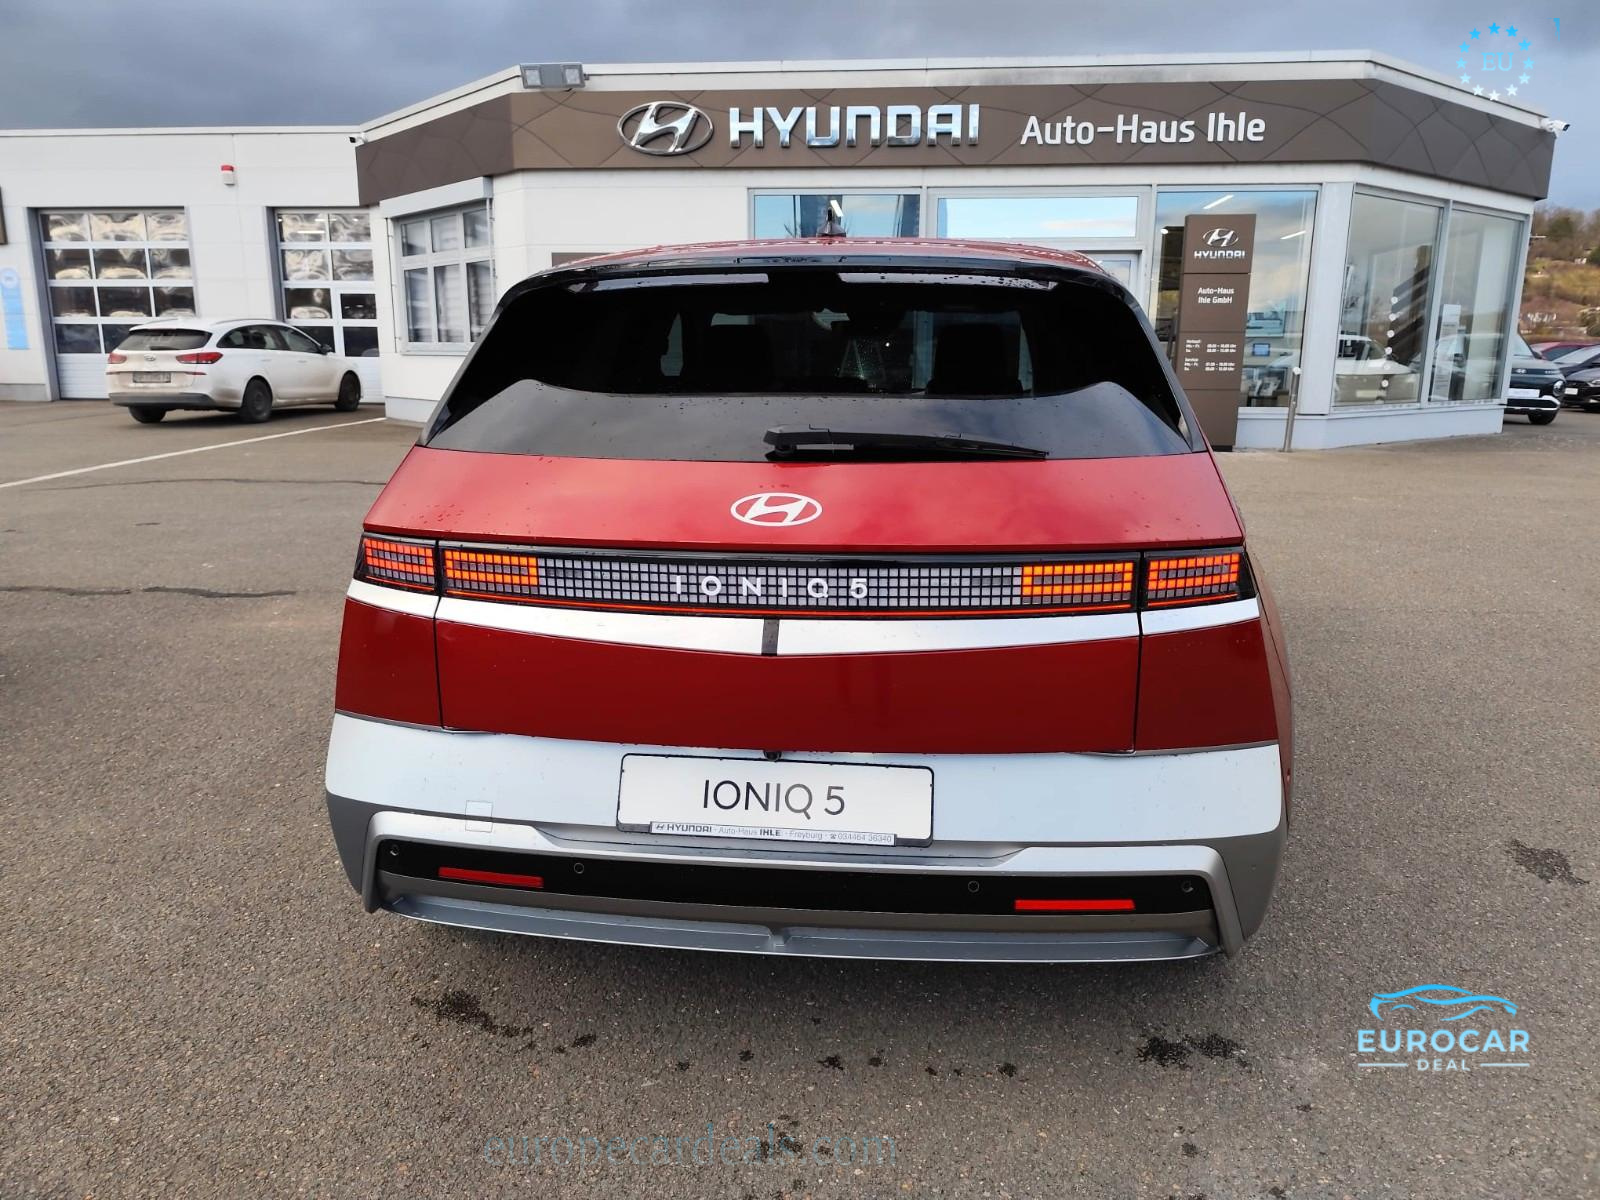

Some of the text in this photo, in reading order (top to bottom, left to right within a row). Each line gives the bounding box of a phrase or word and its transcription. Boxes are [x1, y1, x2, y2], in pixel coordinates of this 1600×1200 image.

[729, 103, 980, 148] HYUNDAI
[1020, 112, 1266, 146] Auto-Haus Ihle
[1194, 250, 1246, 259] HYUNDAI
[1212, 296, 1233, 304] GmbH
[675, 574, 868, 599] IONIQ 5
[703, 779, 846, 820] IONIQ 5
[666, 823, 712, 833] HYUNDAI
[759, 828, 781, 836] IHLE
